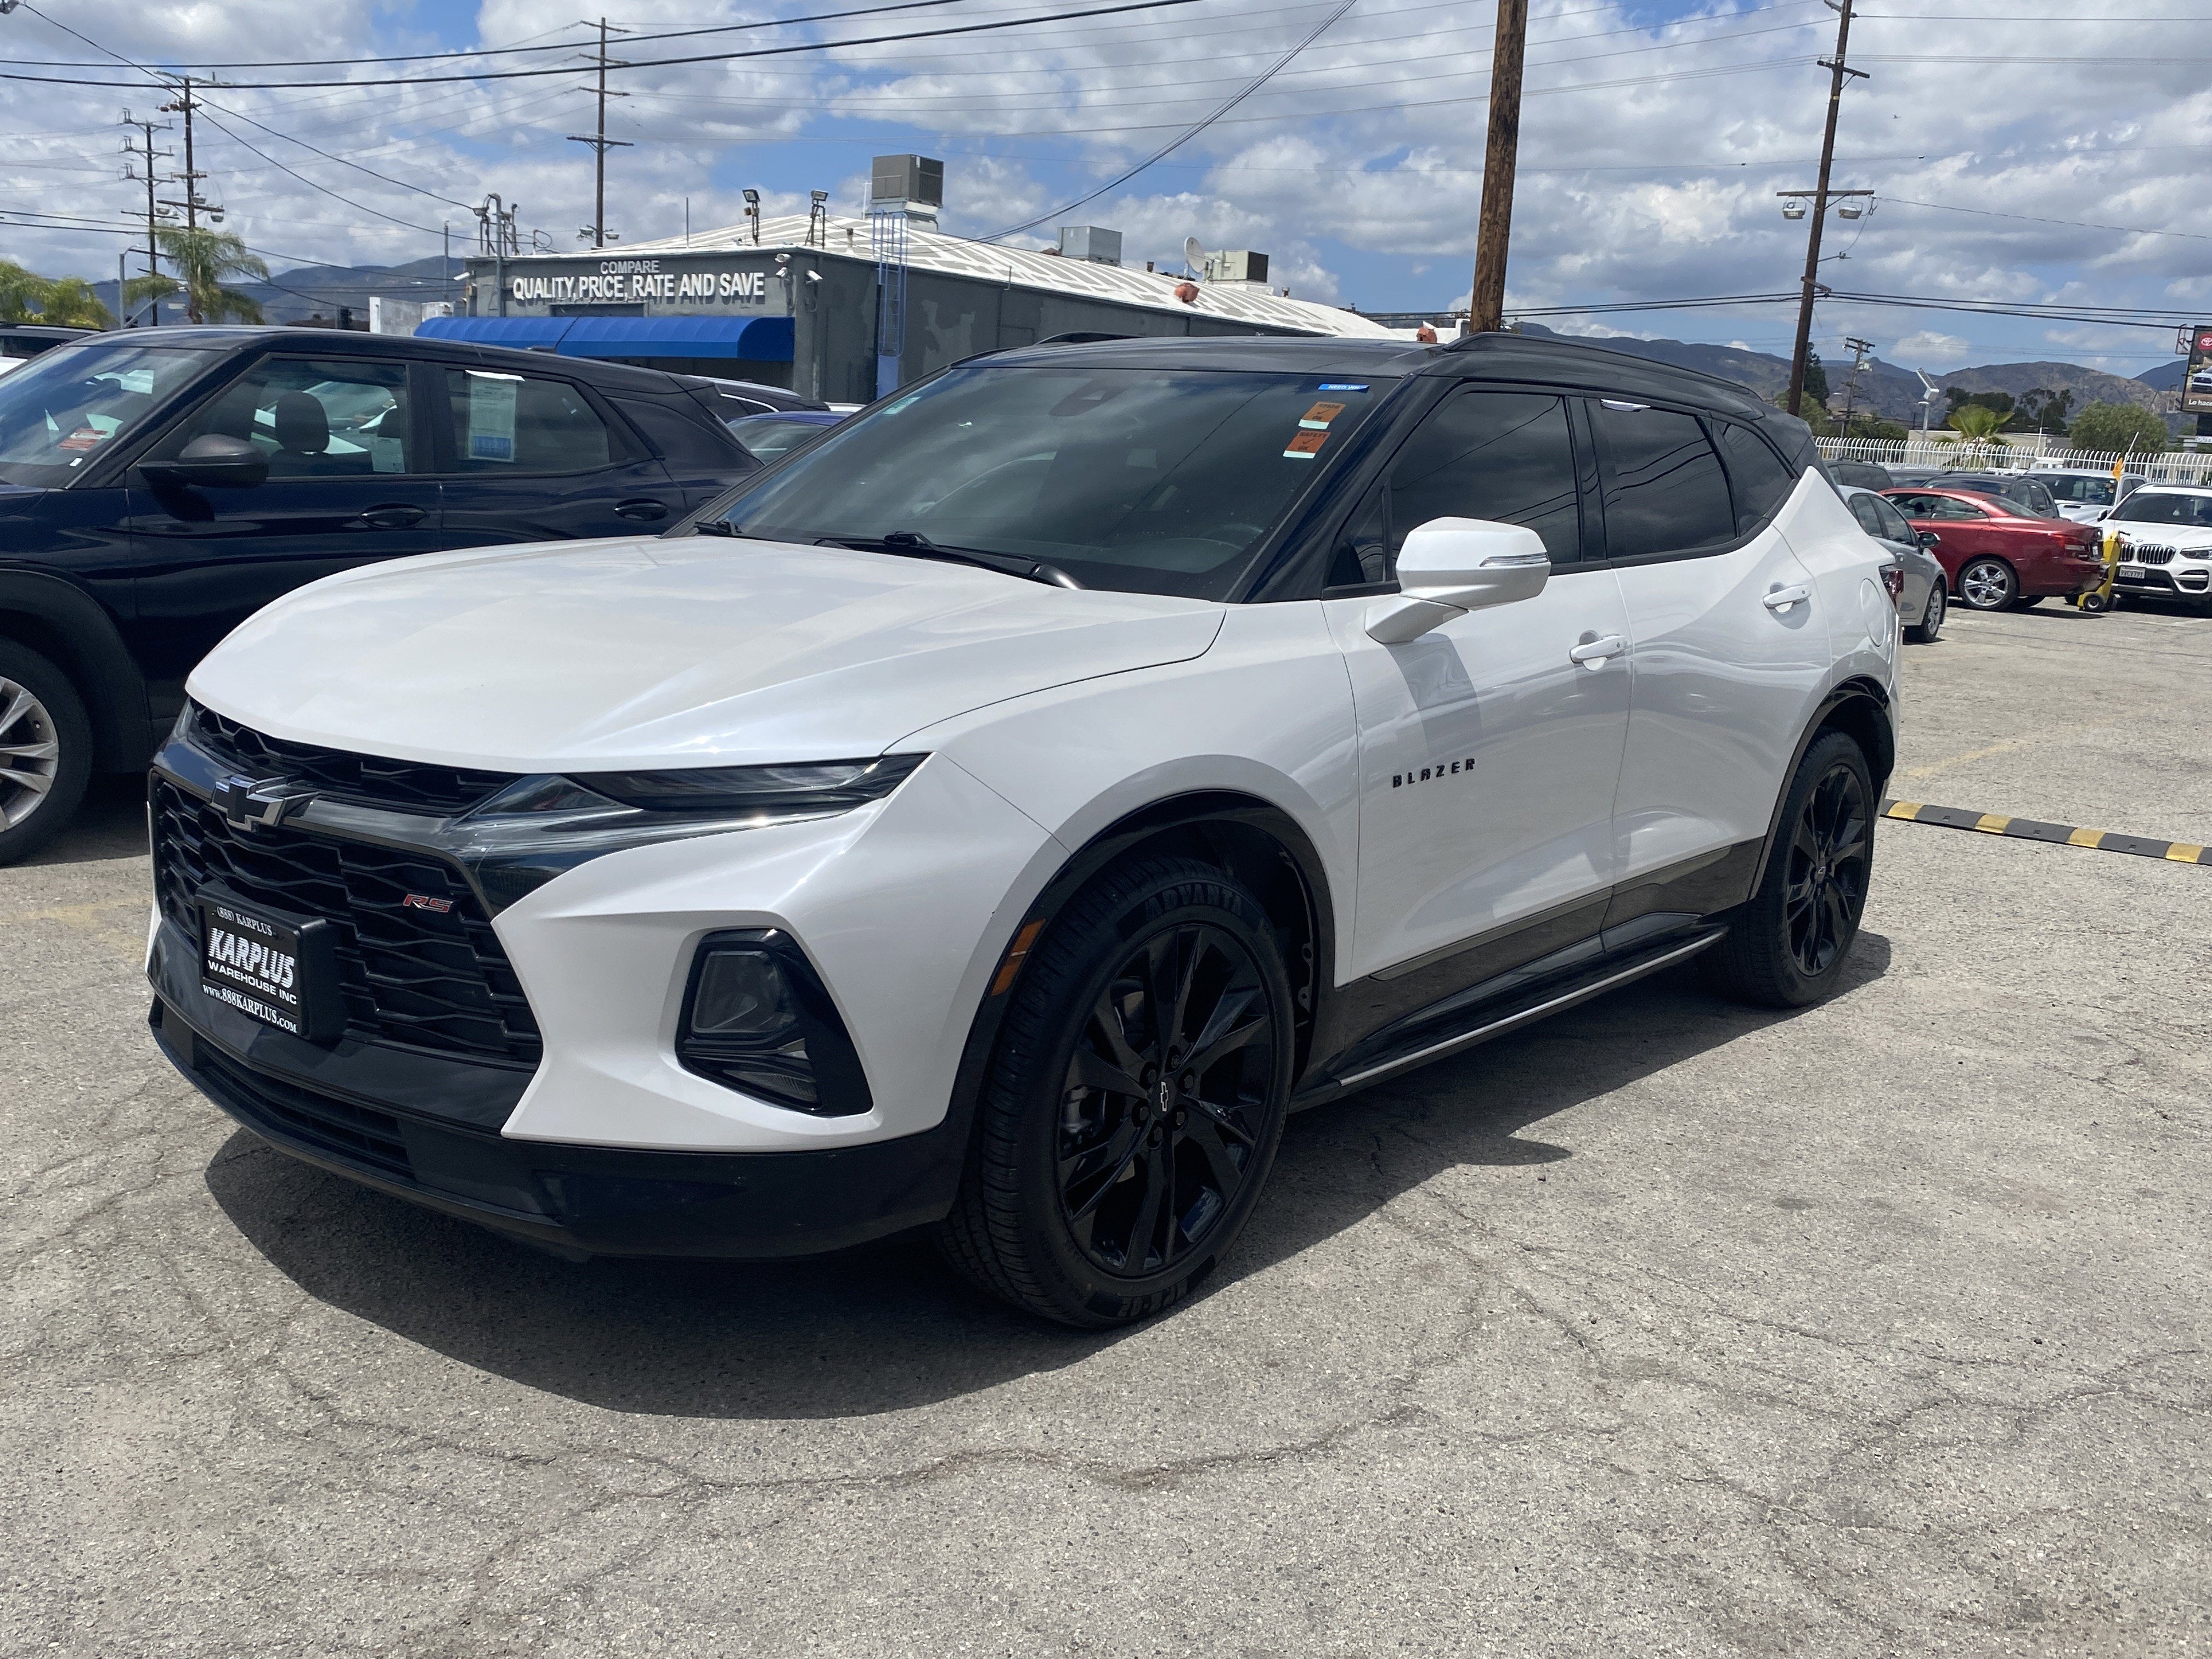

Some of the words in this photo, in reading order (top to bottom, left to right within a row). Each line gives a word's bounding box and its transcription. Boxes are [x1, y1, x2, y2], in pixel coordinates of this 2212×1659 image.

[601, 261, 660, 274] COMPARE
[513, 276, 575, 302] QUALITY,
[579, 275, 628, 302] PRICE,
[633, 274, 675, 296] RATE
[679, 273, 715, 296] AND
[719, 272, 764, 296] SAVE
[1392, 758, 1475, 788] BLAZER
[403, 894, 453, 913] RS
[1145, 883, 1242, 922] ADVANTA
[217, 906, 235, 922] (888)
[235, 913, 273, 936] KARPLUS
[208, 927, 295, 989] KARPLUS
[207, 960, 276, 996] WAREHOUSE
[279, 989, 297, 1005] INC
